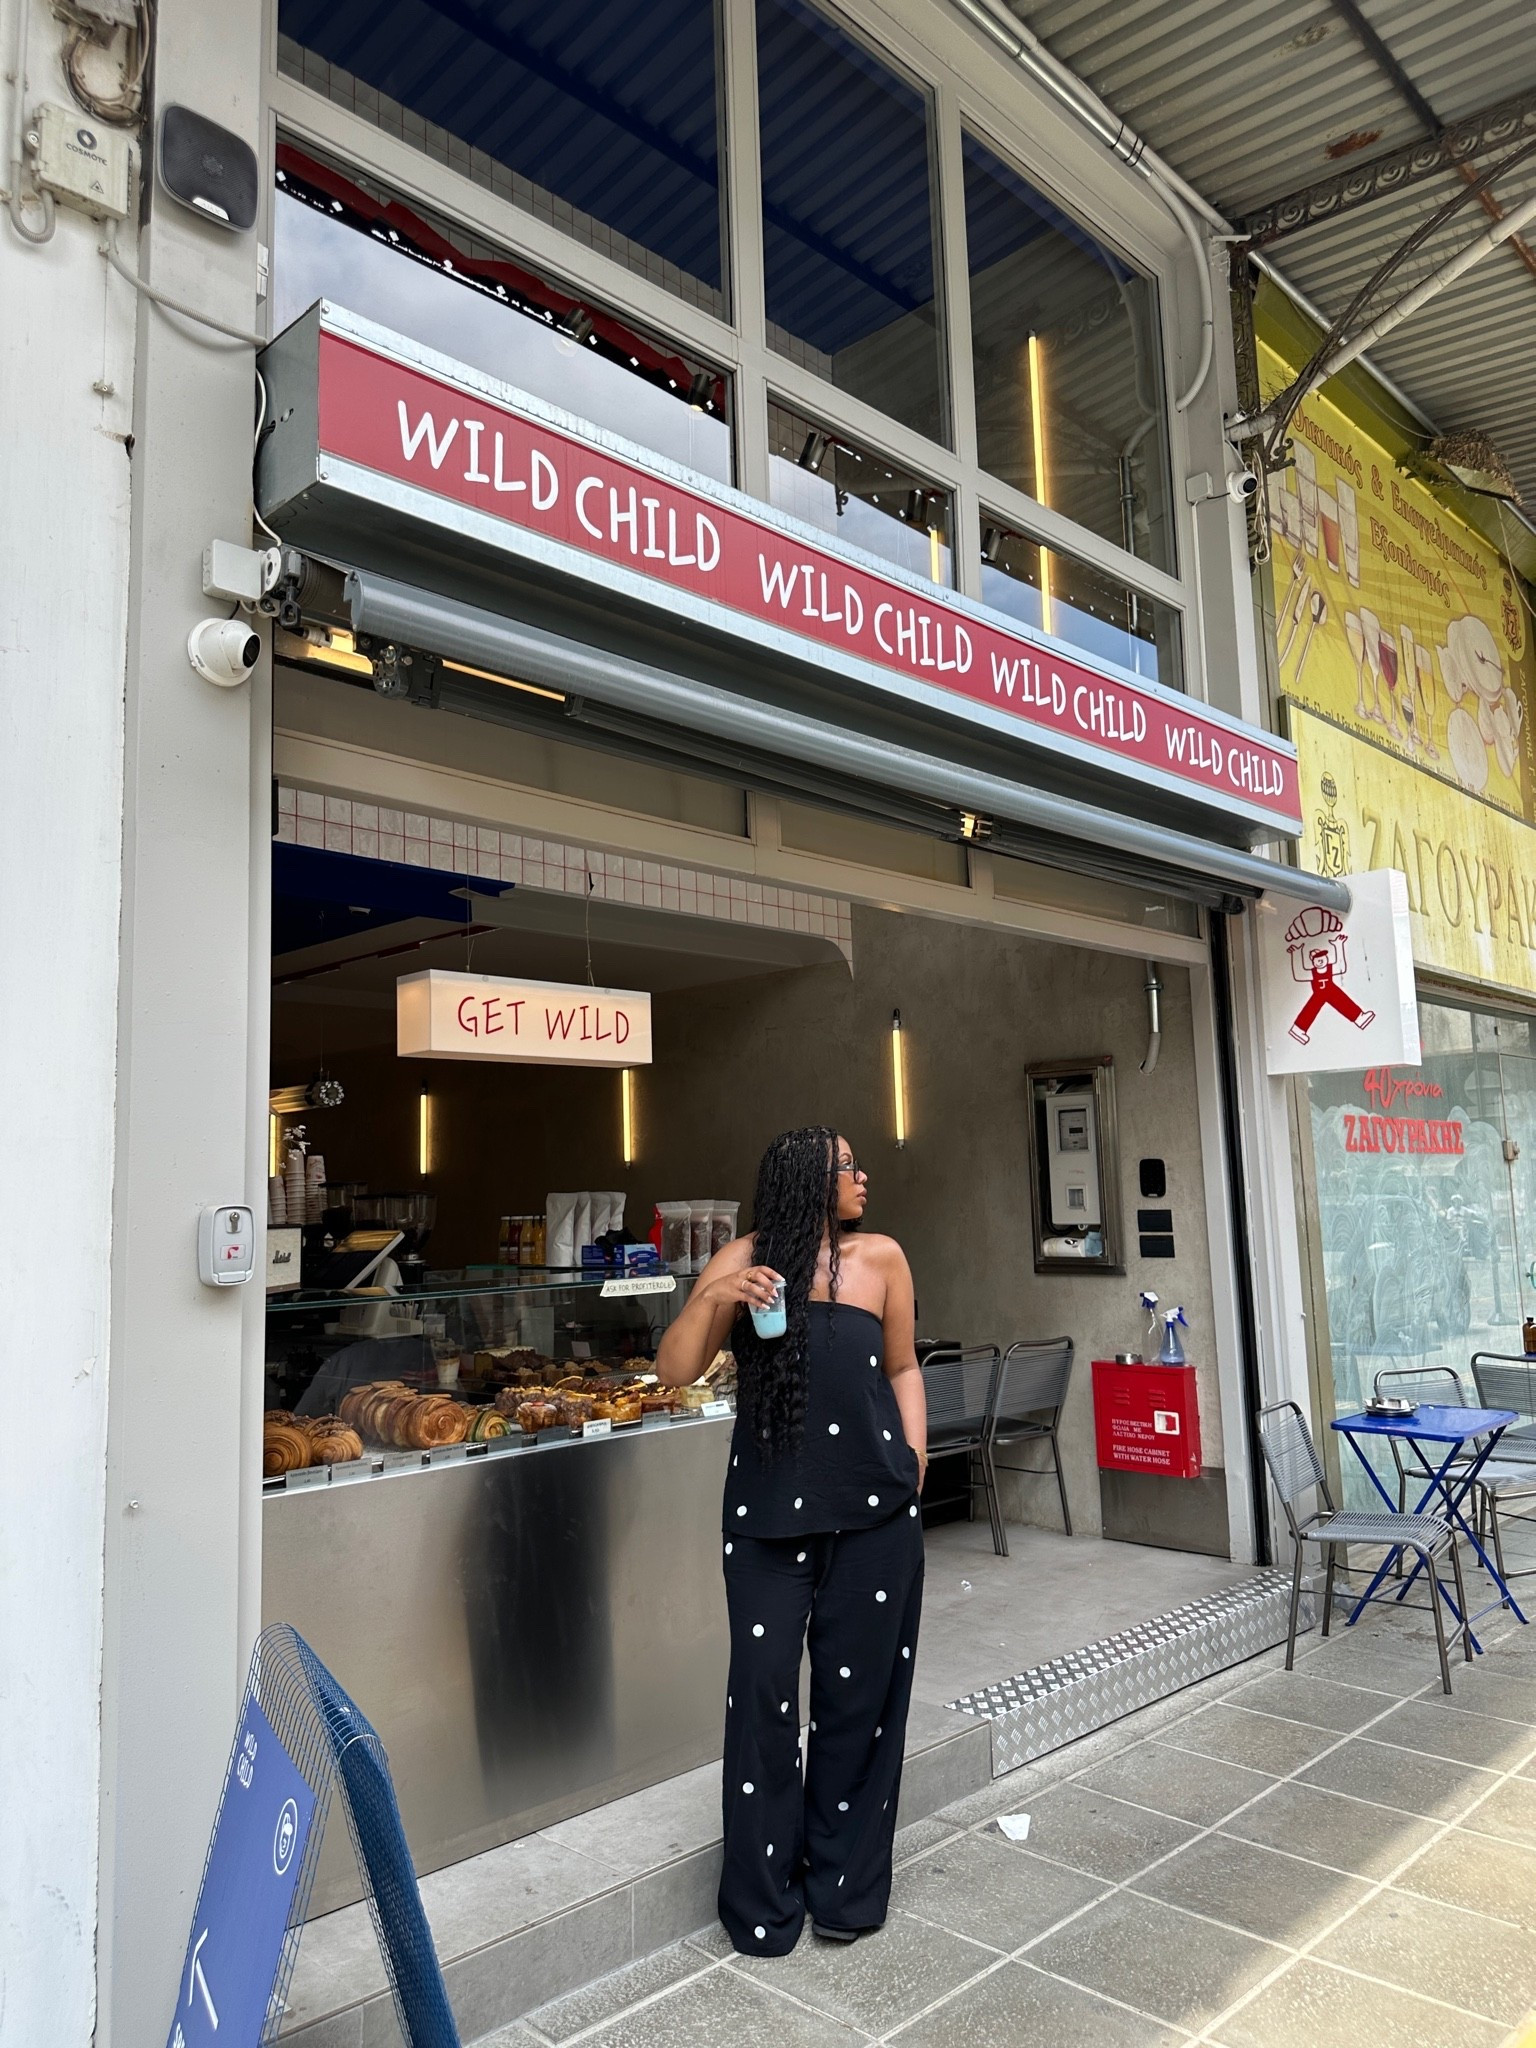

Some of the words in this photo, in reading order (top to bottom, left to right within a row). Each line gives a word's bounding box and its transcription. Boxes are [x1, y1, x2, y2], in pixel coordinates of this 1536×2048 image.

[1371, 464, 1384, 501] &
[1390, 480, 1487, 591] Επαγγελματικός
[1369, 515, 1451, 609] Εξοπλισμός
[397, 399, 559, 511] WILD
[575, 476, 721, 572] CHILD
[757, 553, 864, 635] WILD
[874, 602, 973, 674] CHILD
[990, 651, 1066, 716] WILD
[1073, 685, 1147, 743] CHILD
[1164, 723, 1223, 776] WILD
[1227, 748, 1284, 796] CHILD
[457, 996, 526, 1038] GET
[545, 1005, 630, 1044] WILD
[1343, 1114, 1465, 1155] ΖΑΓΟΥΡΑΚΗΣ
[1130, 1454, 1152, 1462] WATER
[1144, 1448, 1170, 1457] CABINET
